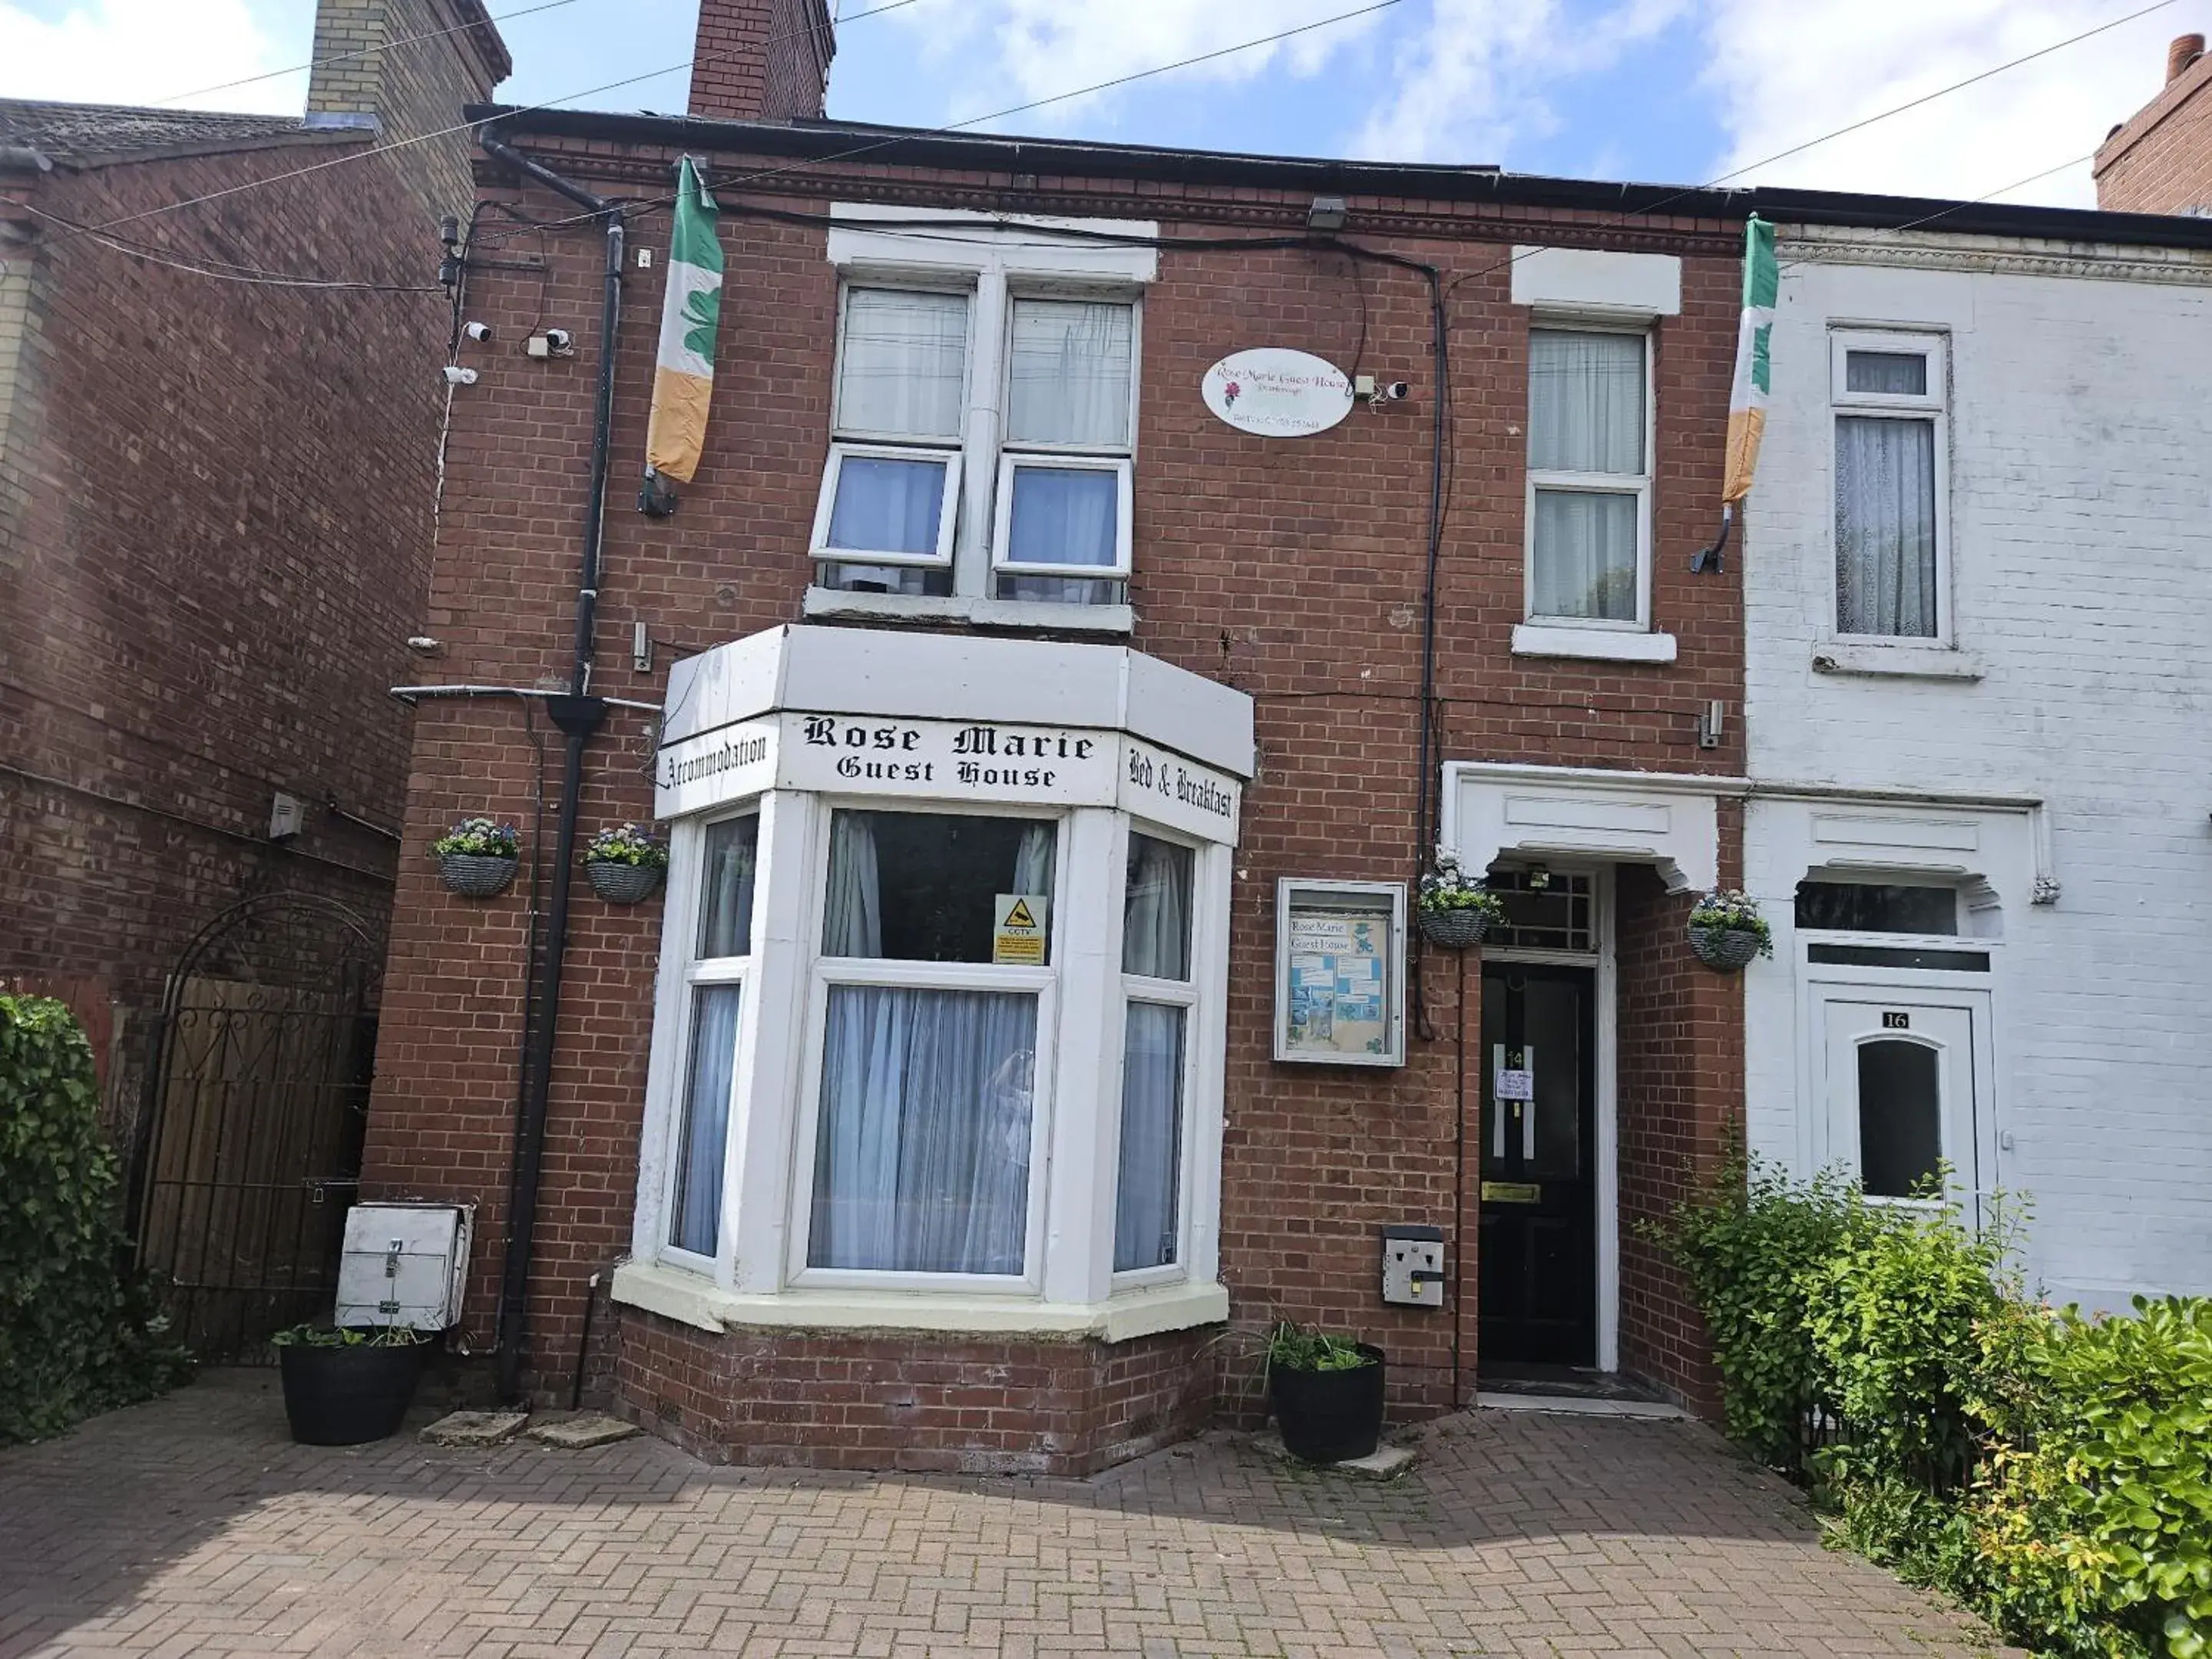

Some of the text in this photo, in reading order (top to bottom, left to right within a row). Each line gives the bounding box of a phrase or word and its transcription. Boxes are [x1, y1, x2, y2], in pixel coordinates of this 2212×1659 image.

[804, 716, 1095, 759] Rose Marie
[667, 736, 767, 788] Accommodation
[836, 755, 1056, 788] Guest House
[1129, 747, 1232, 818] Bed & Breakfast
[1886, 1013, 1907, 1028] 16
[1507, 1051, 1523, 1068] 14
